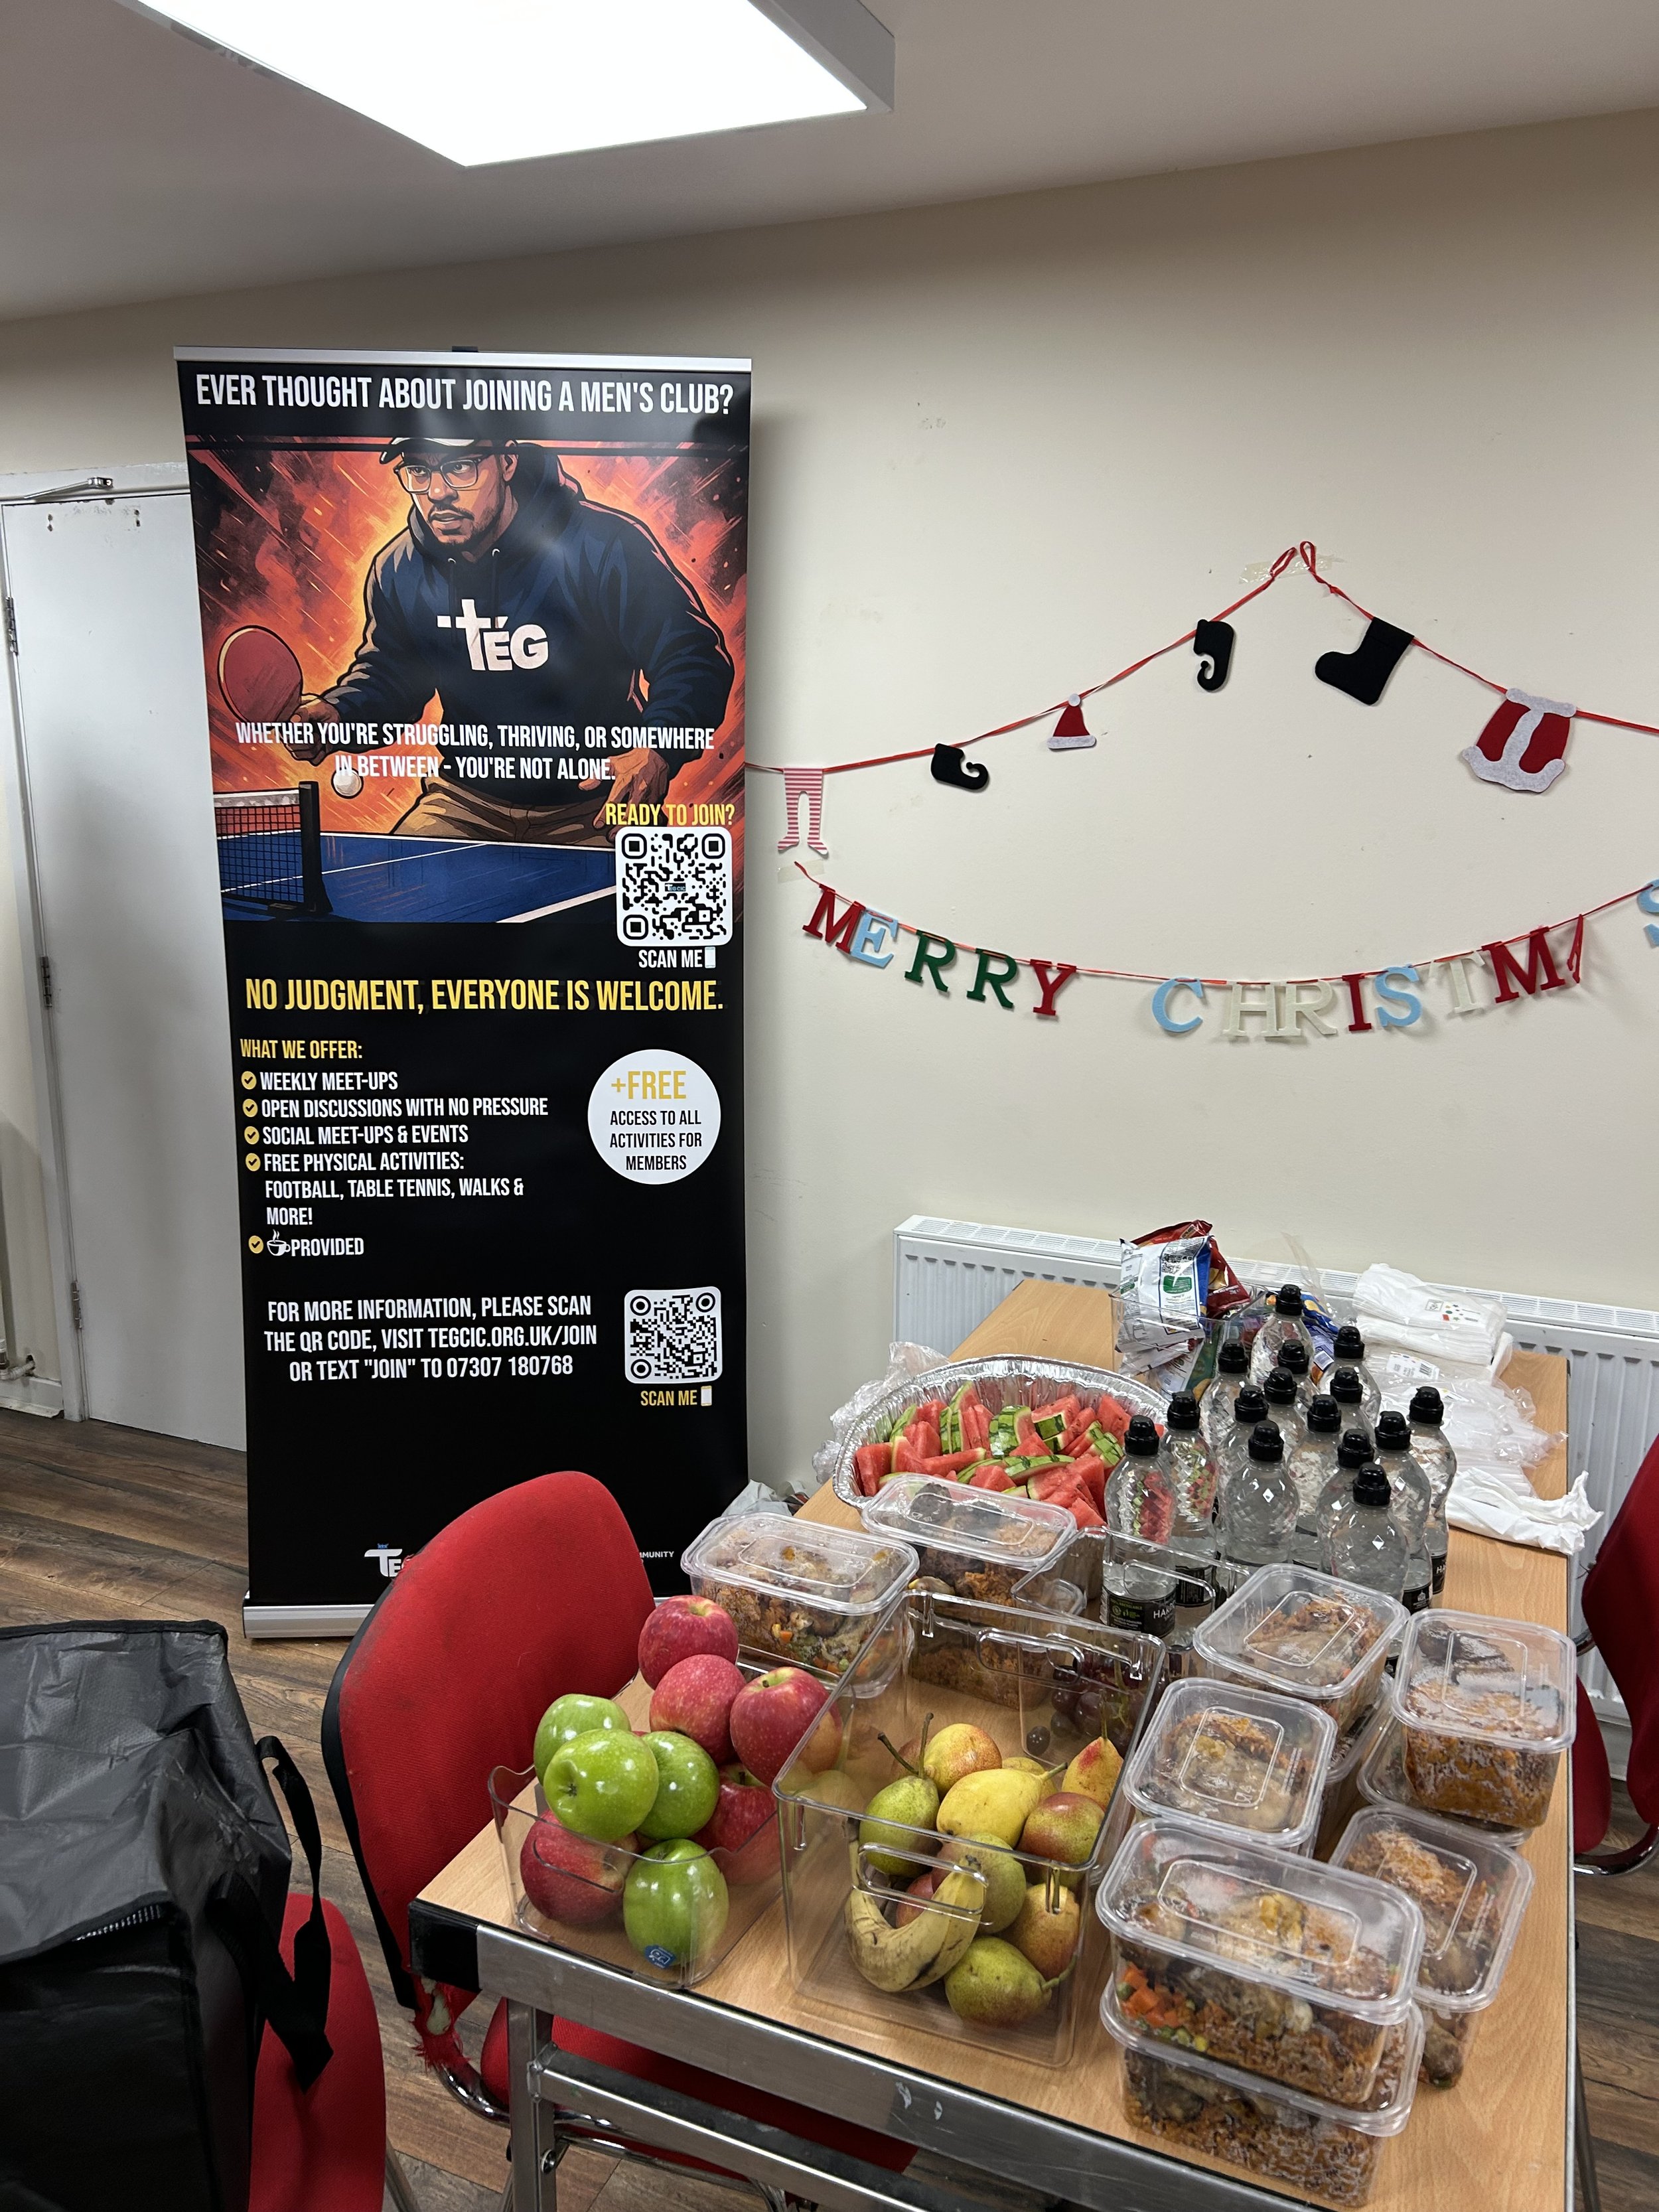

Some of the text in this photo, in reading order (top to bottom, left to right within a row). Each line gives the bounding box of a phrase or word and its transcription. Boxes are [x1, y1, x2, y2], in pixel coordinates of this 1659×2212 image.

[196, 374, 733, 415] EVER THOUGHT ABOUT JOINING A MEN'S CLUB?
[236, 722, 714, 751] WHETHER YOU'RE STRUGGLING, THRIVING, OR SOMEWHERE
[335, 755, 352, 776] IN
[357, 755, 439, 778] BETWEEN
[455, 757, 516, 778] YOU'RE
[520, 758, 553, 779] NOT
[557, 759, 616, 780] ALONE.
[605, 804, 735, 826] READY TO JOIN?
[638, 950, 703, 968] SCAN ME
[802, 883, 1077, 1016] MERRY
[246, 978, 723, 1015] NO JUDGMENT, EVERYONE IS WELCOME.
[240, 1039, 362, 1059] WHAT WE OFFER:
[259, 1071, 398, 1091] WEEKLY MEET-UPS
[611, 1070, 687, 1100] +FREE
[261, 1097, 549, 1118] OPEN DISCUSSIONS WITH NO PRESSURE
[611, 1110, 701, 1126] ACCESS TO ALL
[262, 1124, 469, 1145] SOCIAL MEET-UPS & EVENTS
[610, 1132, 702, 1148] ACTIVITIES FOR
[263, 1151, 465, 1172] FREE PHYSICAL ACTIVITIES:
[626, 1155, 687, 1171] MEMBERS
[265, 1177, 524, 1201] FOOTBALL, TABLE TENNIS, WALKS &
[266, 1207, 313, 1226] MORE!
[291, 1237, 364, 1257] PROVIDED
[268, 1295, 591, 1322] FOR MORE INFORMATION, PLEASE SCAN
[264, 1325, 597, 1353] THE QR CODE, VISIT TEGCIC.ORG.UK/JOIN
[289, 1355, 573, 1382] OR TEXT "JOIN" TO 07307 180768
[640, 1390, 697, 1406] SCAN ME
[364, 1548, 404, 1578] TE
